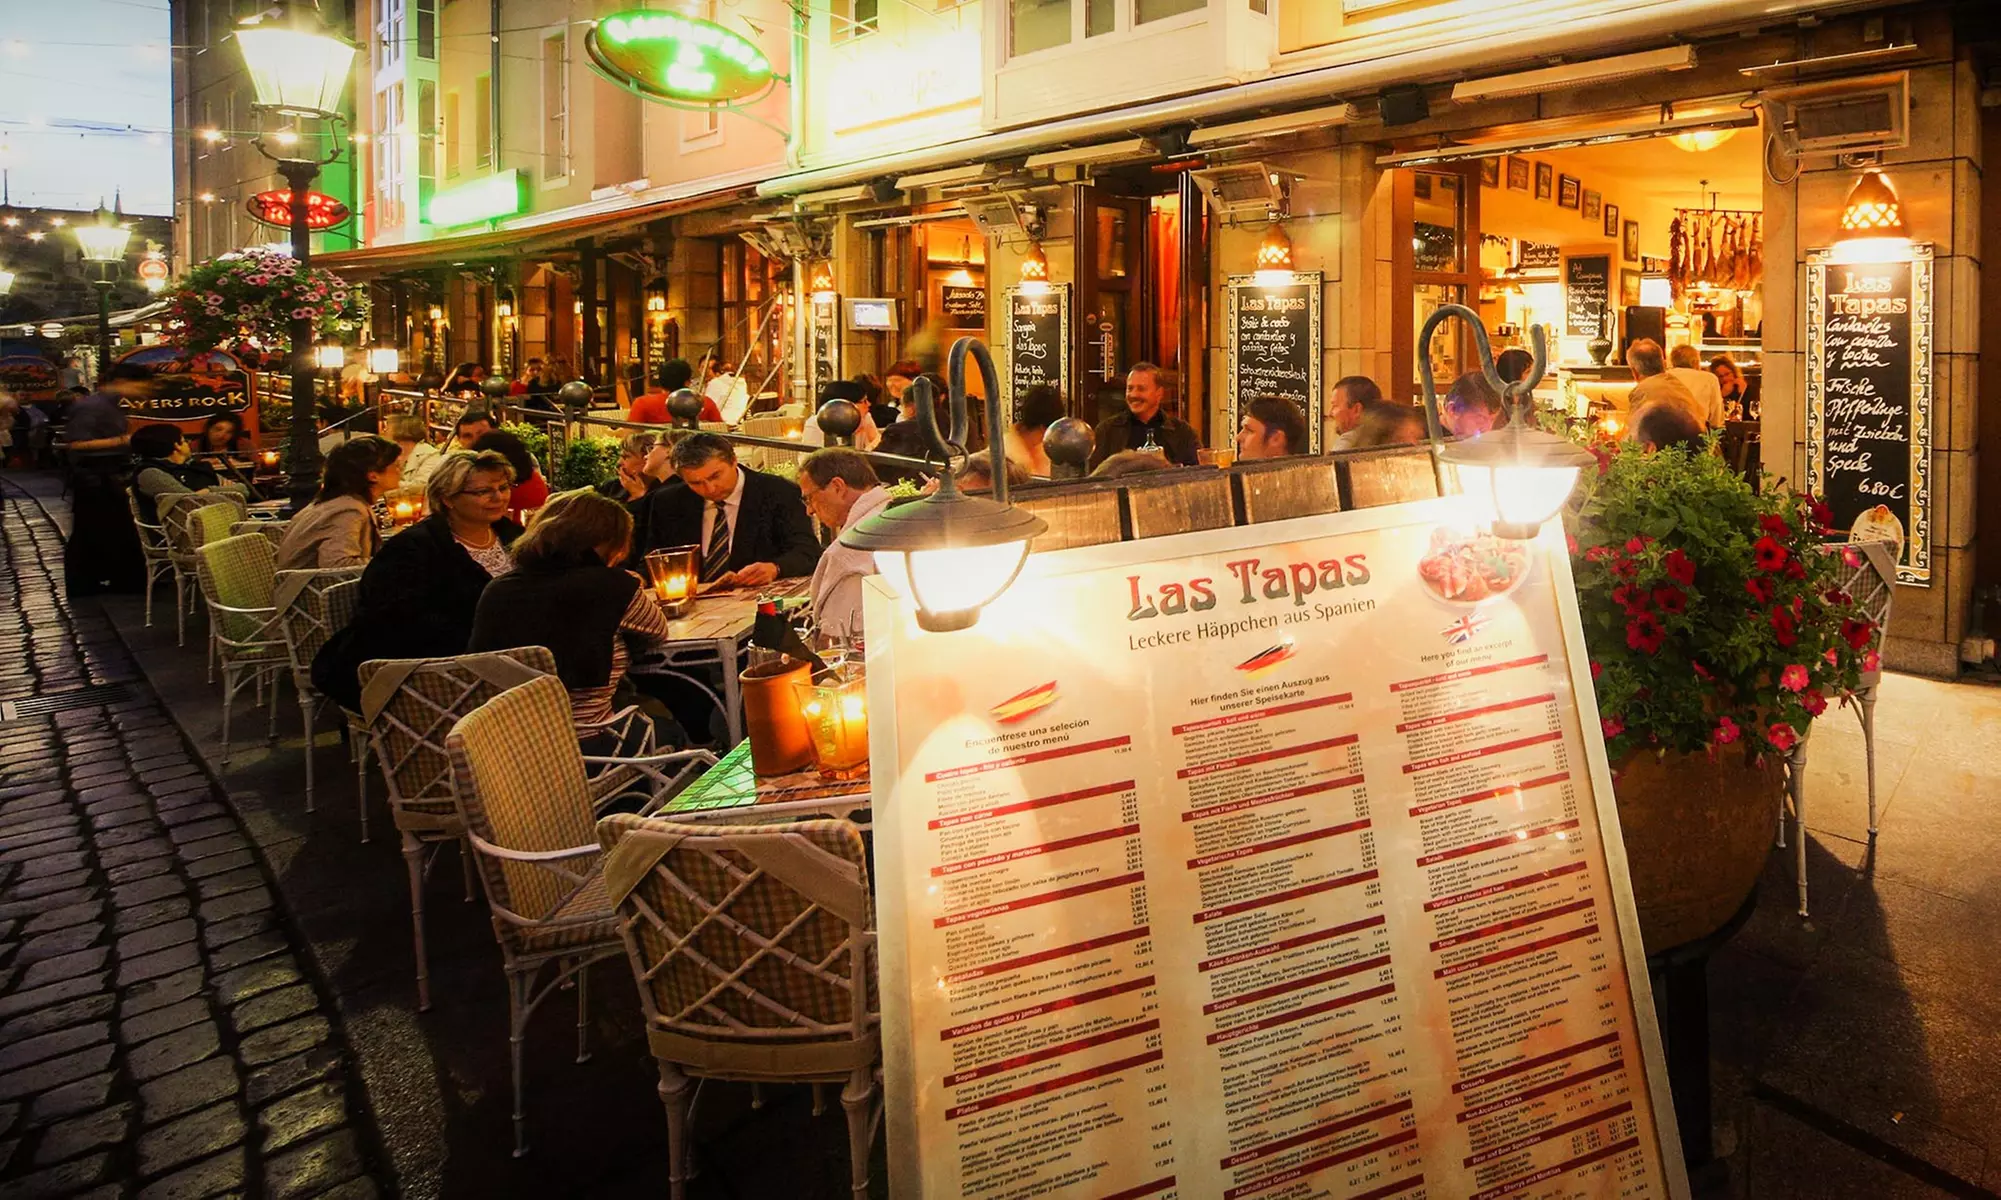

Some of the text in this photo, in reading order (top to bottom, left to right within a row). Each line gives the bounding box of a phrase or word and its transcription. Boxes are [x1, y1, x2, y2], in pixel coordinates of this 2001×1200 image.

[1843, 271, 1892, 293] Las
[1014, 301, 1058, 317] Las Tapas
[1241, 294, 1306, 314] Las Tapas
[1828, 294, 1907, 318] Tapas
[1826, 350, 1837, 368] y
[1826, 377, 1876, 396] Frische
[118, 397, 184, 410] AYERS
[1827, 422, 1850, 437] mit
[1828, 438, 1859, 453] und
[1826, 452, 1872, 478] Speck
[1126, 553, 1371, 621] Las Tapas
[1129, 597, 1377, 651] Leckere Häppchen aus Spanien
[1420, 652, 1439, 662] Here
[1440, 650, 1455, 660] you
[1456, 646, 1472, 655] find
[1445, 659, 1454, 667] of
[1190, 674, 1330, 706] Hier finden Sie einen Auszug aus
[1219, 688, 1305, 711] unserer Speisekarte
[964, 717, 1089, 748] Encuentrese una seleción
[1404, 721, 1421, 731] Tapas
[987, 732, 1069, 755] de nuestro menú
[1187, 759, 1237, 777] Tapas mit Fleisch
[1411, 761, 1427, 771] Tapas
[1427, 758, 1439, 766] with
[1449, 753, 1460, 761] and
[1460, 749, 1481, 759] seafood
[1191, 809, 1209, 820] Tapas
[1210, 806, 1221, 814] mit
[1221, 803, 1237, 812] Fisch
[1238, 800, 1250, 808] und
[1417, 797, 1462, 814] Vegetarian Tapas
[939, 816, 959, 828] Tapas
[973, 811, 993, 820] carne
[941, 845, 1041, 875] Tapas con pescado y mariscos
[1196, 846, 1253, 866] Vegetarische Tapas
[1432, 896, 1456, 908] Variation
[1462, 889, 1482, 900] cheese
[1482, 886, 1493, 895] and
[1493, 883, 1505, 892] ham
[945, 903, 1009, 925] Tapas vegetarianas
[1203, 908, 1222, 919] Salate
[1438, 937, 1456, 949] Soups
[1442, 961, 1479, 975] Main courses
[1213, 998, 1237, 1012] Suppen
[952, 1005, 1043, 1035] Variados de queso y jamón
[1216, 1022, 1259, 1042] Hauptgerichte
[954, 1070, 977, 1084] Sopas
[1460, 1076, 1485, 1090] Desserts
[1504, 1094, 1522, 1106] Drinks
[956, 1103, 979, 1116] Platos
[1230, 1149, 1258, 1165] Desserts
